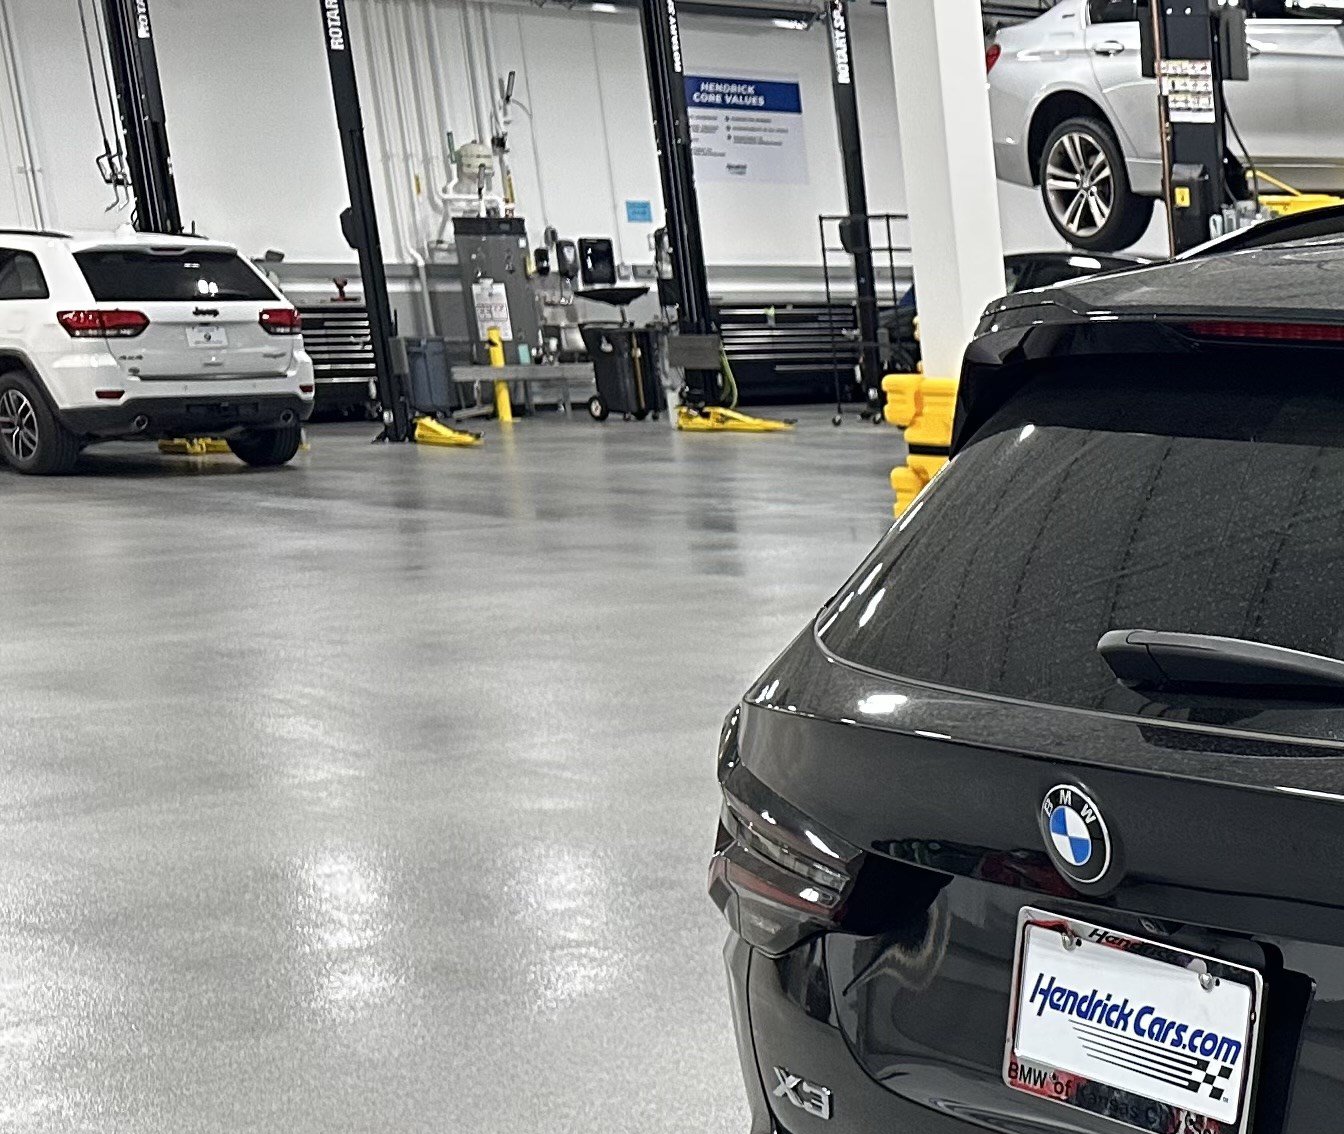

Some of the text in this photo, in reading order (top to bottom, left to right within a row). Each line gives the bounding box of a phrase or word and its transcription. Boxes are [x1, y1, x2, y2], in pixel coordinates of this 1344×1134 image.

[693, 91, 765, 107] CORE VALUES
[700, 82, 755, 95] HENDRICK
[1044, 789, 1097, 824] BMW
[772, 1066, 831, 1120] X3
[1008, 1061, 1047, 1089] BMW
[1054, 1080, 1073, 1098] of
